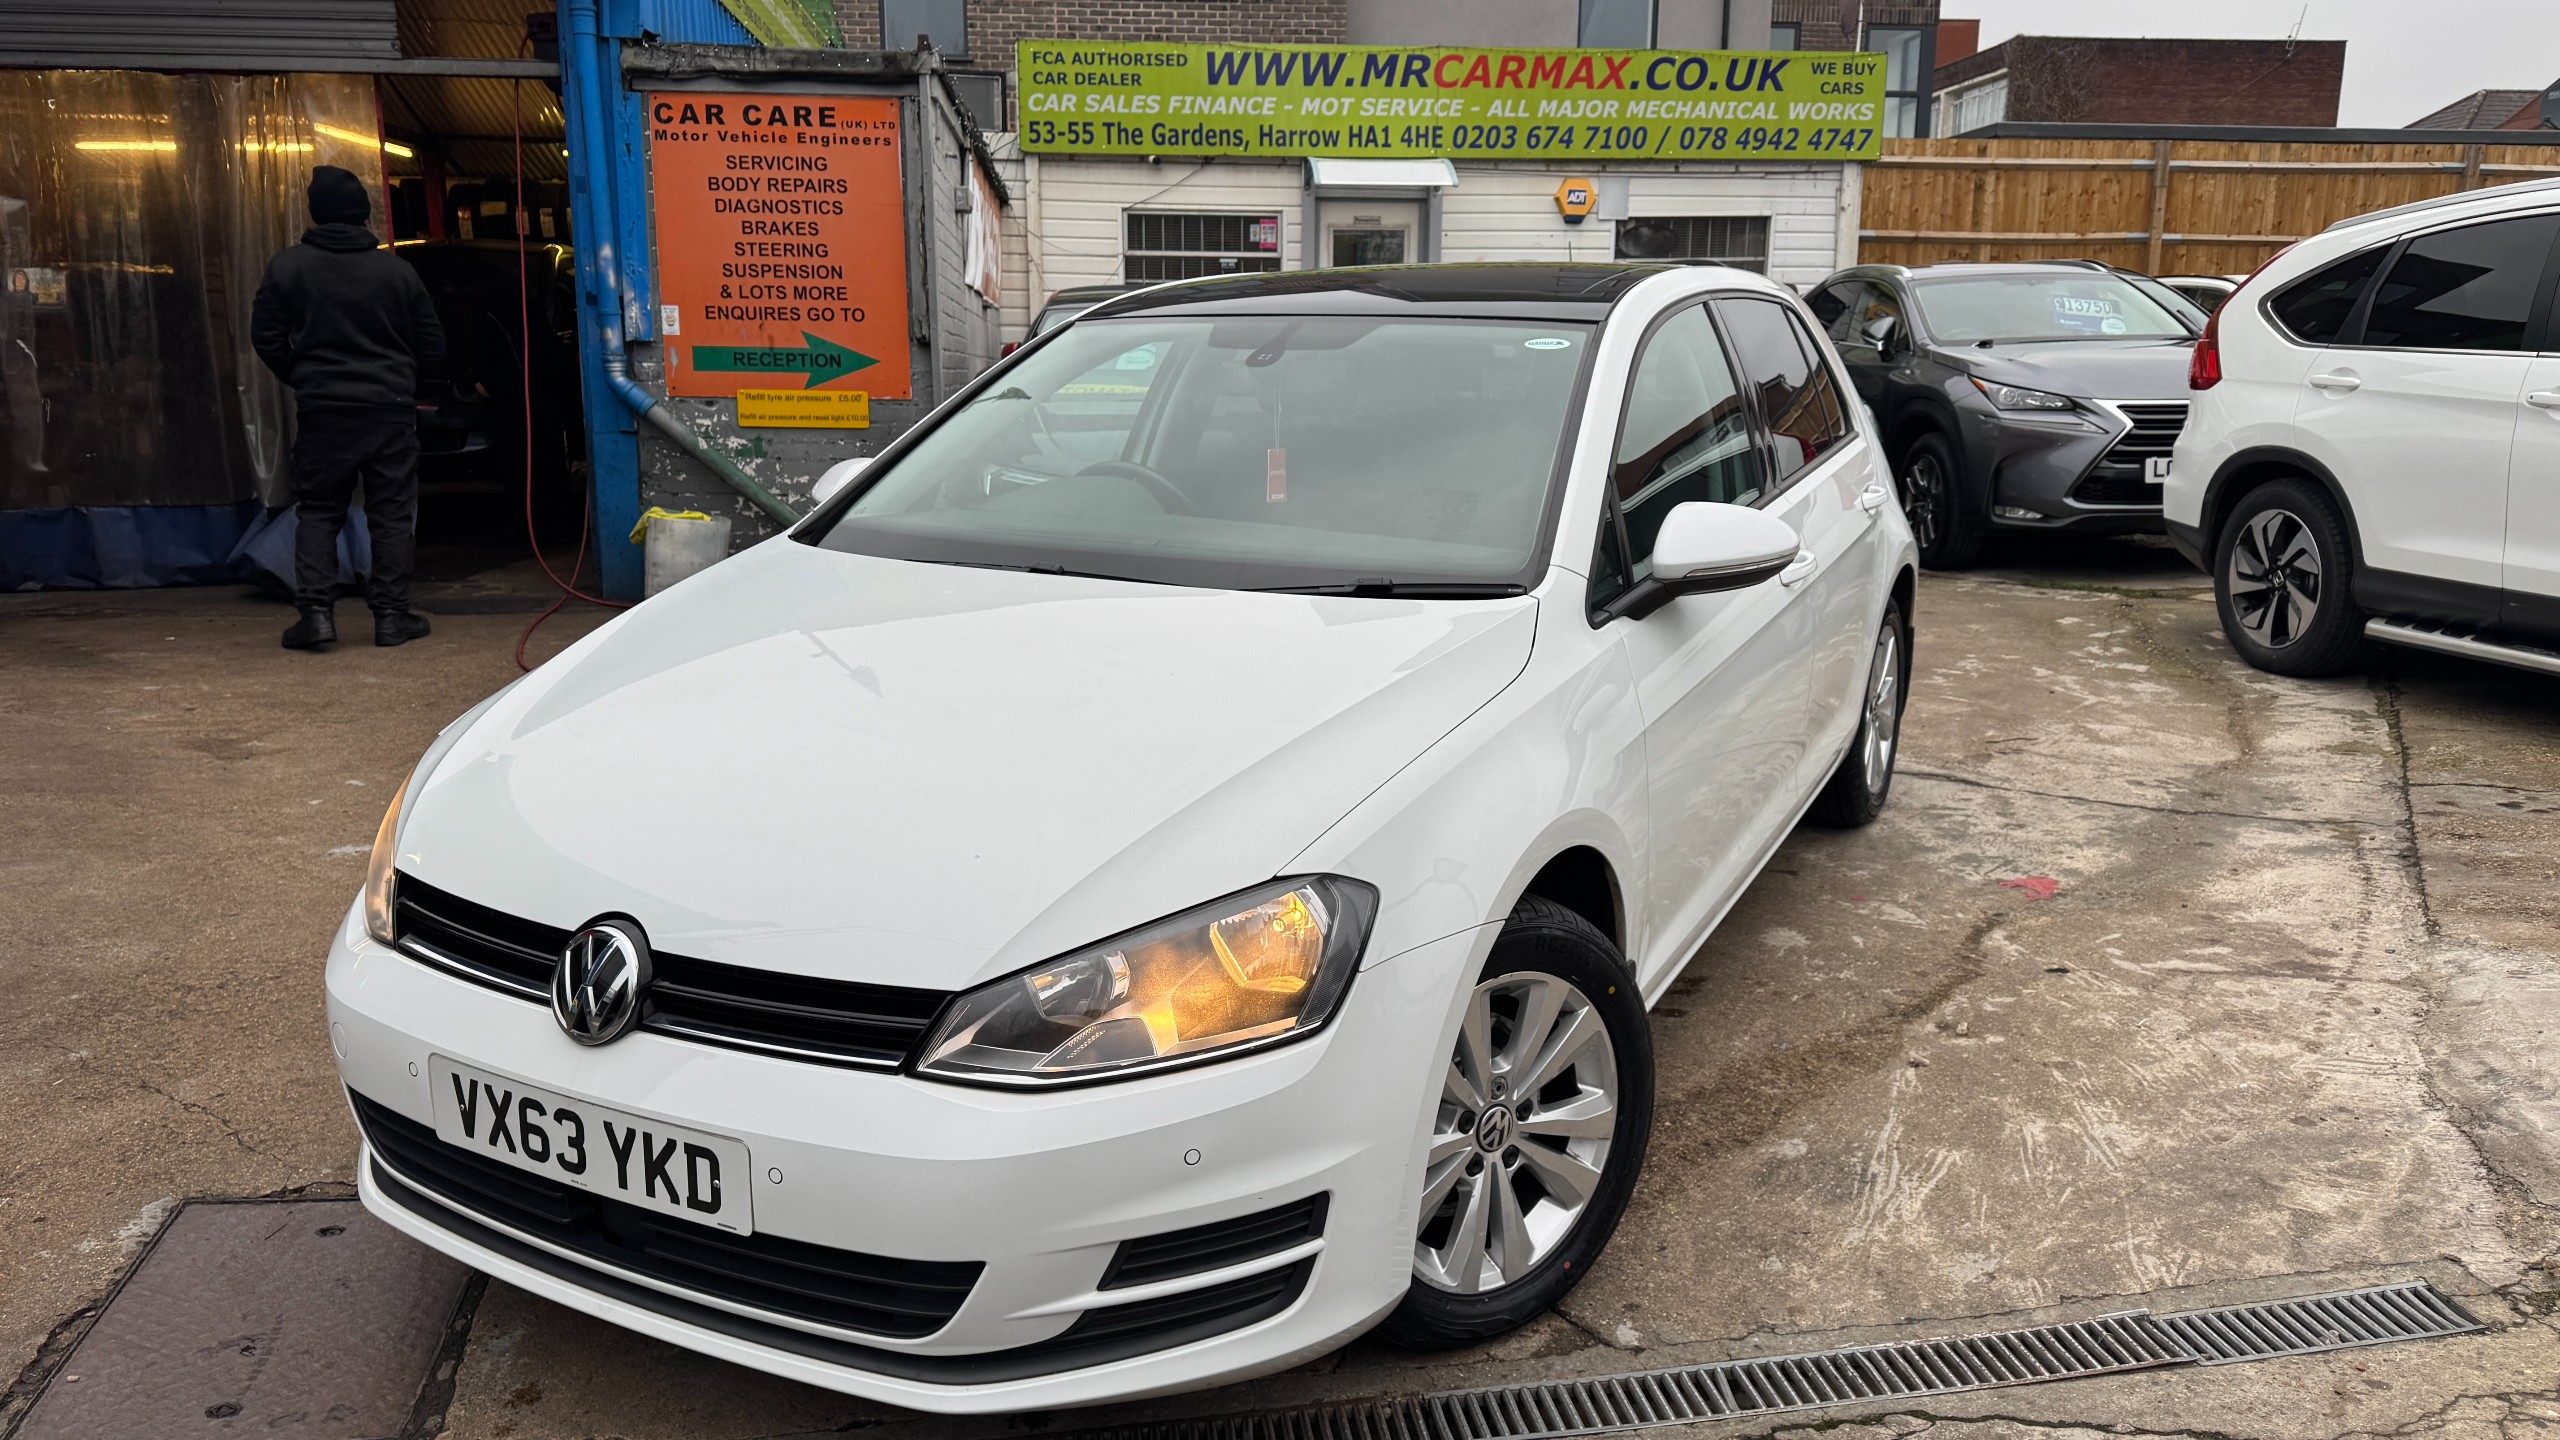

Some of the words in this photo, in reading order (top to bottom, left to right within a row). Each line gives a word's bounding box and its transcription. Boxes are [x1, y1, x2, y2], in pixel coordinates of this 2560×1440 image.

[1032, 51, 1065, 65] FCA
[1071, 52, 1188, 66] AUTHORISED
[1206, 51, 1791, 92] WWW.MRCARMAX.CO.UK
[1811, 62, 1837, 75] WE
[1843, 62, 1877, 75] BUY
[1033, 72, 1068, 85] CAR
[1074, 73, 1142, 86] DEALER
[1820, 82, 1865, 95] CARS
[1028, 93, 1077, 112] CAR
[1084, 94, 1161, 114] SALES
[1168, 96, 1277, 115] FINANCE
[1300, 97, 1355, 116] MOT
[1359, 98, 1465, 117] SERVICE
[1486, 99, 1530, 118] ALL
[1537, 100, 1618, 119] MAJOR
[1626, 100, 1779, 120] MECHANICAL
[1788, 102, 1875, 121] WORKS
[654, 103, 725, 125] CAR
[742, 104, 837, 128] CARE
[841, 120, 868, 130] (UK)
[873, 121, 896, 130] LTD
[654, 129, 709, 142] Motor
[717, 130, 788, 143] Vehicle
[797, 131, 892, 147] Engineers
[1028, 121, 1095, 145] 53-55
[1102, 122, 1144, 145] The
[1151, 122, 1250, 152] Gardens,
[1259, 123, 1340, 148] Harrow
[1348, 125, 1392, 148] HA1
[1400, 125, 1444, 148] 4HE
[1452, 125, 1517, 149] 0203
[1526, 125, 1574, 149] 674
[1583, 126, 1648, 150] 7100
[1654, 125, 1672, 154] /
[1679, 126, 1728, 150] 078
[1735, 127, 1800, 151] 4942
[1807, 128, 1873, 151] 4747
[726, 155, 828, 171] SERVICING
[707, 176, 760, 192] BODY
[767, 178, 848, 193] REPAIRS
[1567, 191, 1587, 204] ADT
[714, 198, 844, 215] DIAGNOSTICS
[741, 220, 819, 236] BRAKES
[734, 242, 829, 258] STEERING
[722, 263, 843, 280] SUSPENSION
[720, 285, 733, 299] &
[739, 285, 787, 300] LOTS
[793, 286, 848, 301] MORE
[705, 306, 801, 321] ENQUIRES
[807, 307, 835, 322] GO
[840, 308, 865, 323] TO
[733, 352, 842, 368] RECEPTION
[745, 392, 765, 401] Refill
[767, 393, 783, 403] tyre
[785, 393, 794, 401] air
[797, 394, 832, 403] pressure
[838, 394, 862, 403] £5.00
[740, 412, 756, 420] Refill
[451, 1072, 588, 1176] VX63
[603, 1120, 722, 1215] YKD
